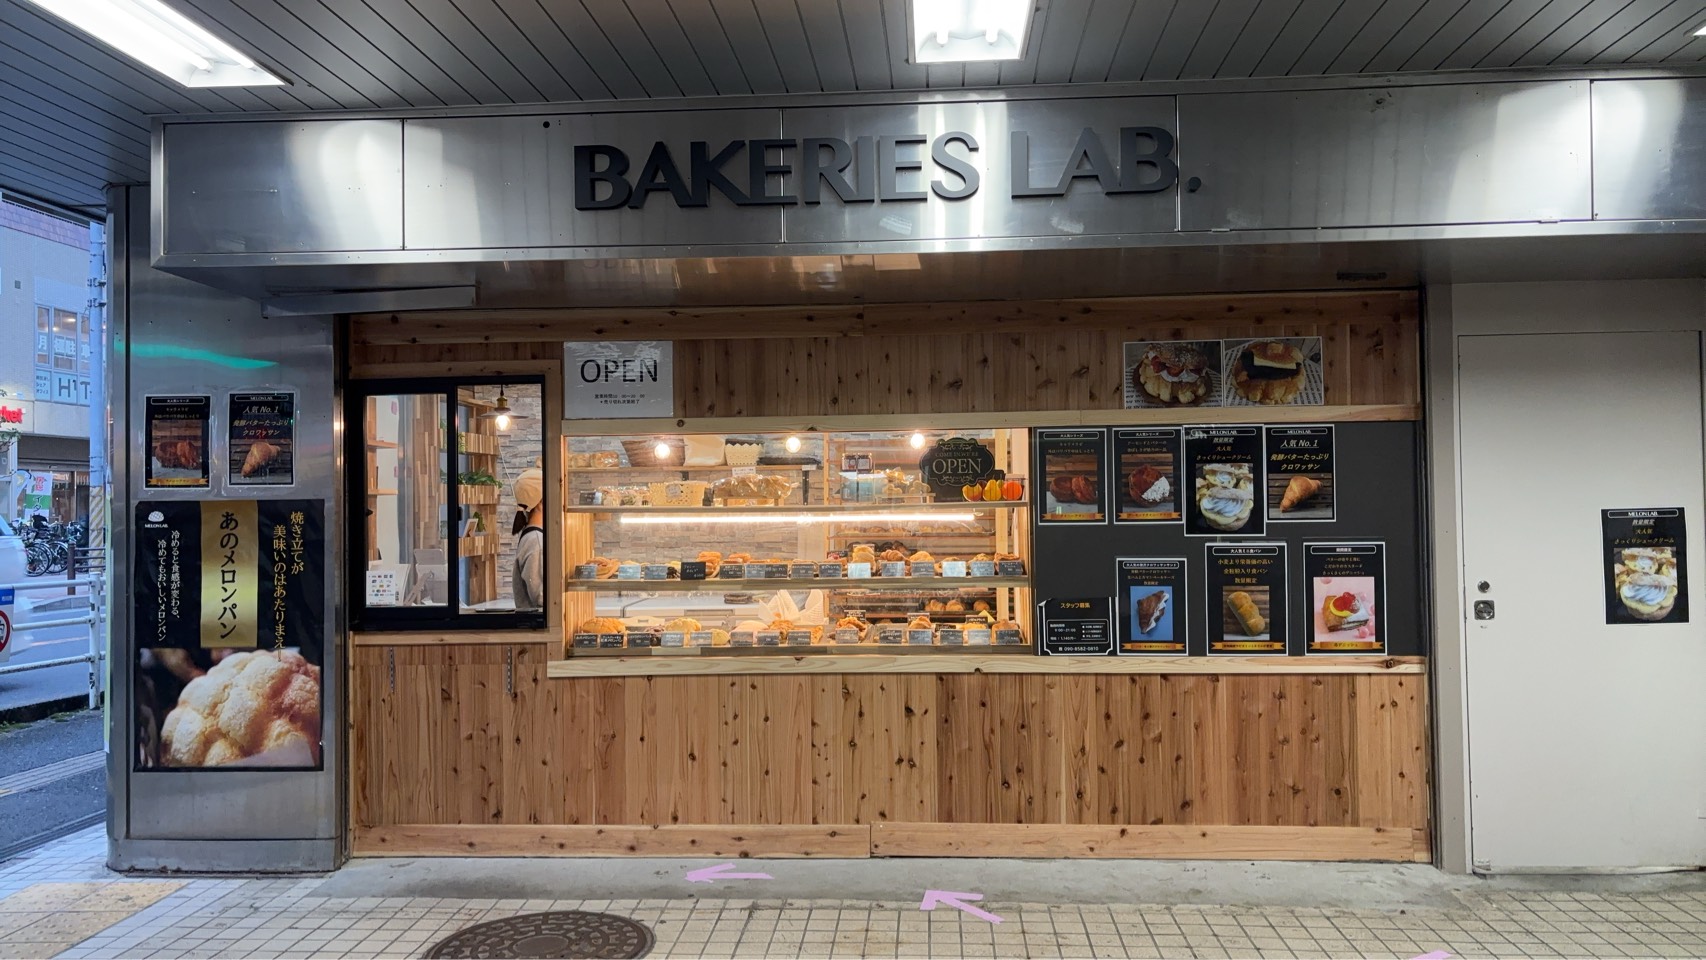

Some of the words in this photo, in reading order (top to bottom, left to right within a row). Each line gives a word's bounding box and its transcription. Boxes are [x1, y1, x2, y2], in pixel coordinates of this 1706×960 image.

[573, 130, 981, 211] BAKERIES
[1010, 126, 1202, 199] LAB.
[580, 359, 658, 383] OPEN
[0, 405, 24, 424] ket
[243, 405, 259, 413] 人気
[233, 419, 290, 427] 発酵バターたっぷり
[1281, 439, 1297, 447] 人気
[1270, 453, 1329, 461] 発酵バターたっぷり
[932, 458, 982, 475] OPEN
[1280, 463, 1320, 471] クロワッサン
[290, 511, 304, 575] 焼き立てが
[217, 511, 239, 640] あのメロンパン
[157, 539, 167, 642] 冷めてもおいしいメロンパン
